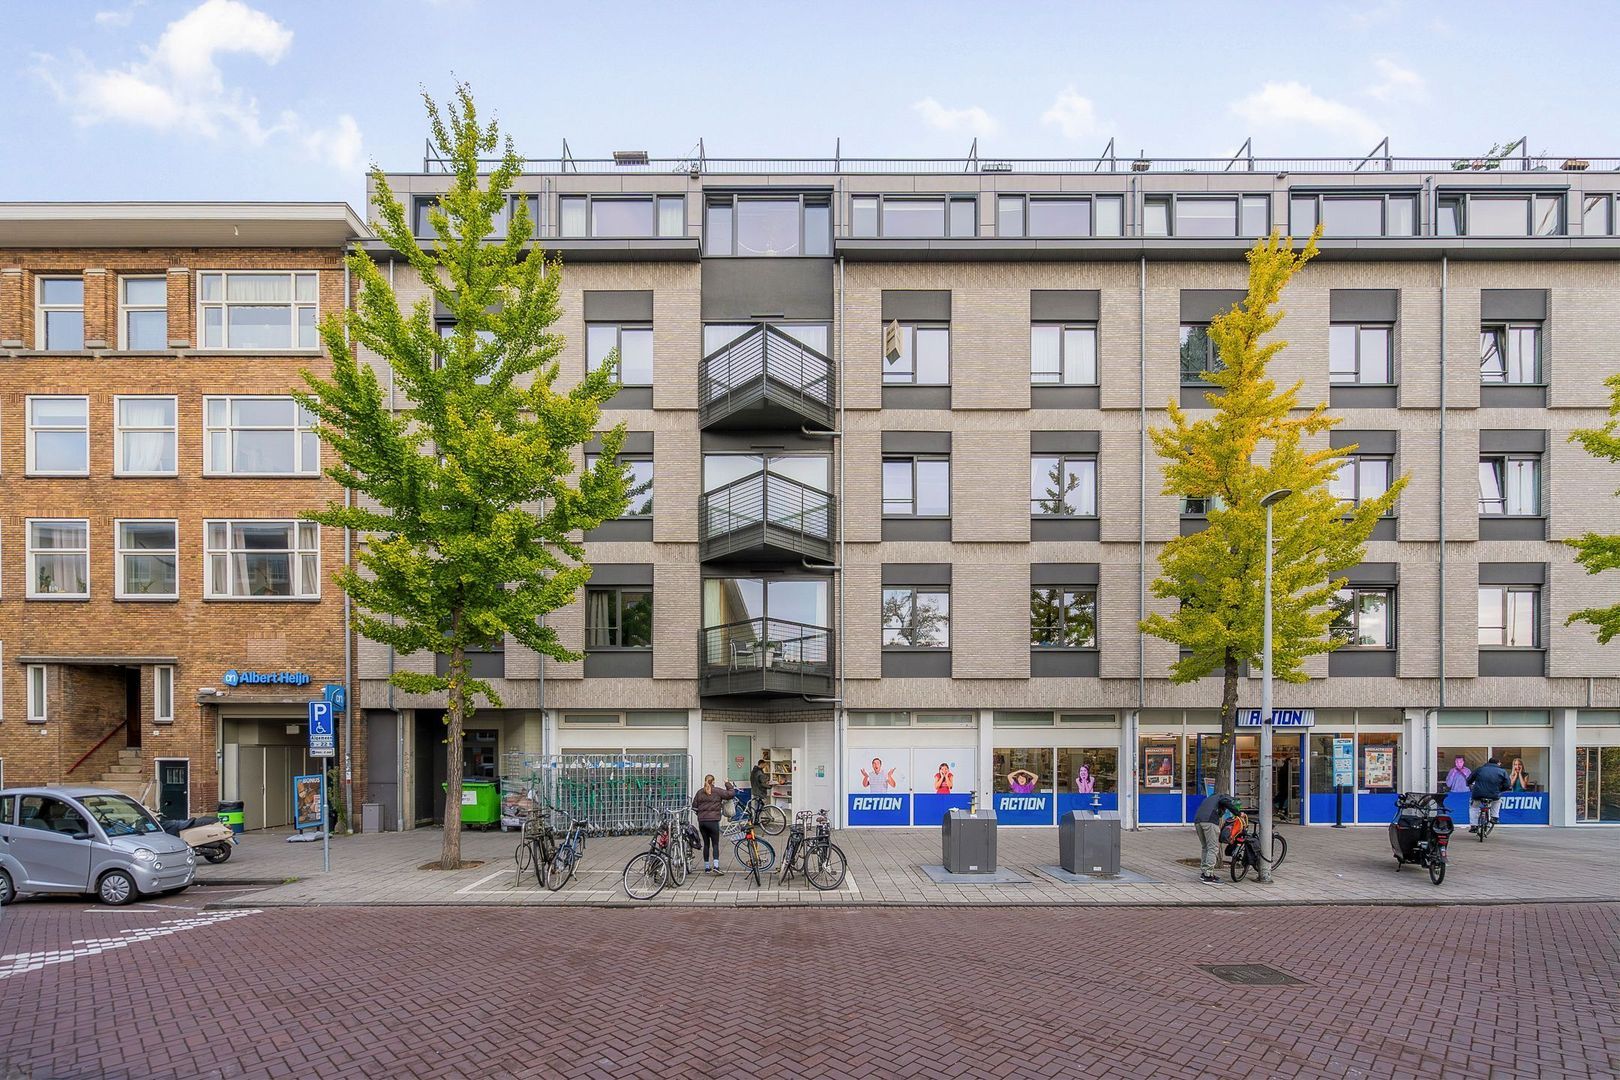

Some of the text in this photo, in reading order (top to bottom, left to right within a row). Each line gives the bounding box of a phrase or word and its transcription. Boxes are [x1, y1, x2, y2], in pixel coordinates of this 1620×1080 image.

[239, 671, 278, 684] Albert
[279, 671, 310, 686] Heijn
[314, 703, 327, 721] P
[1249, 710, 1303, 725] ATION
[853, 797, 902, 811] ACTION
[1000, 797, 1046, 811] ACTION
